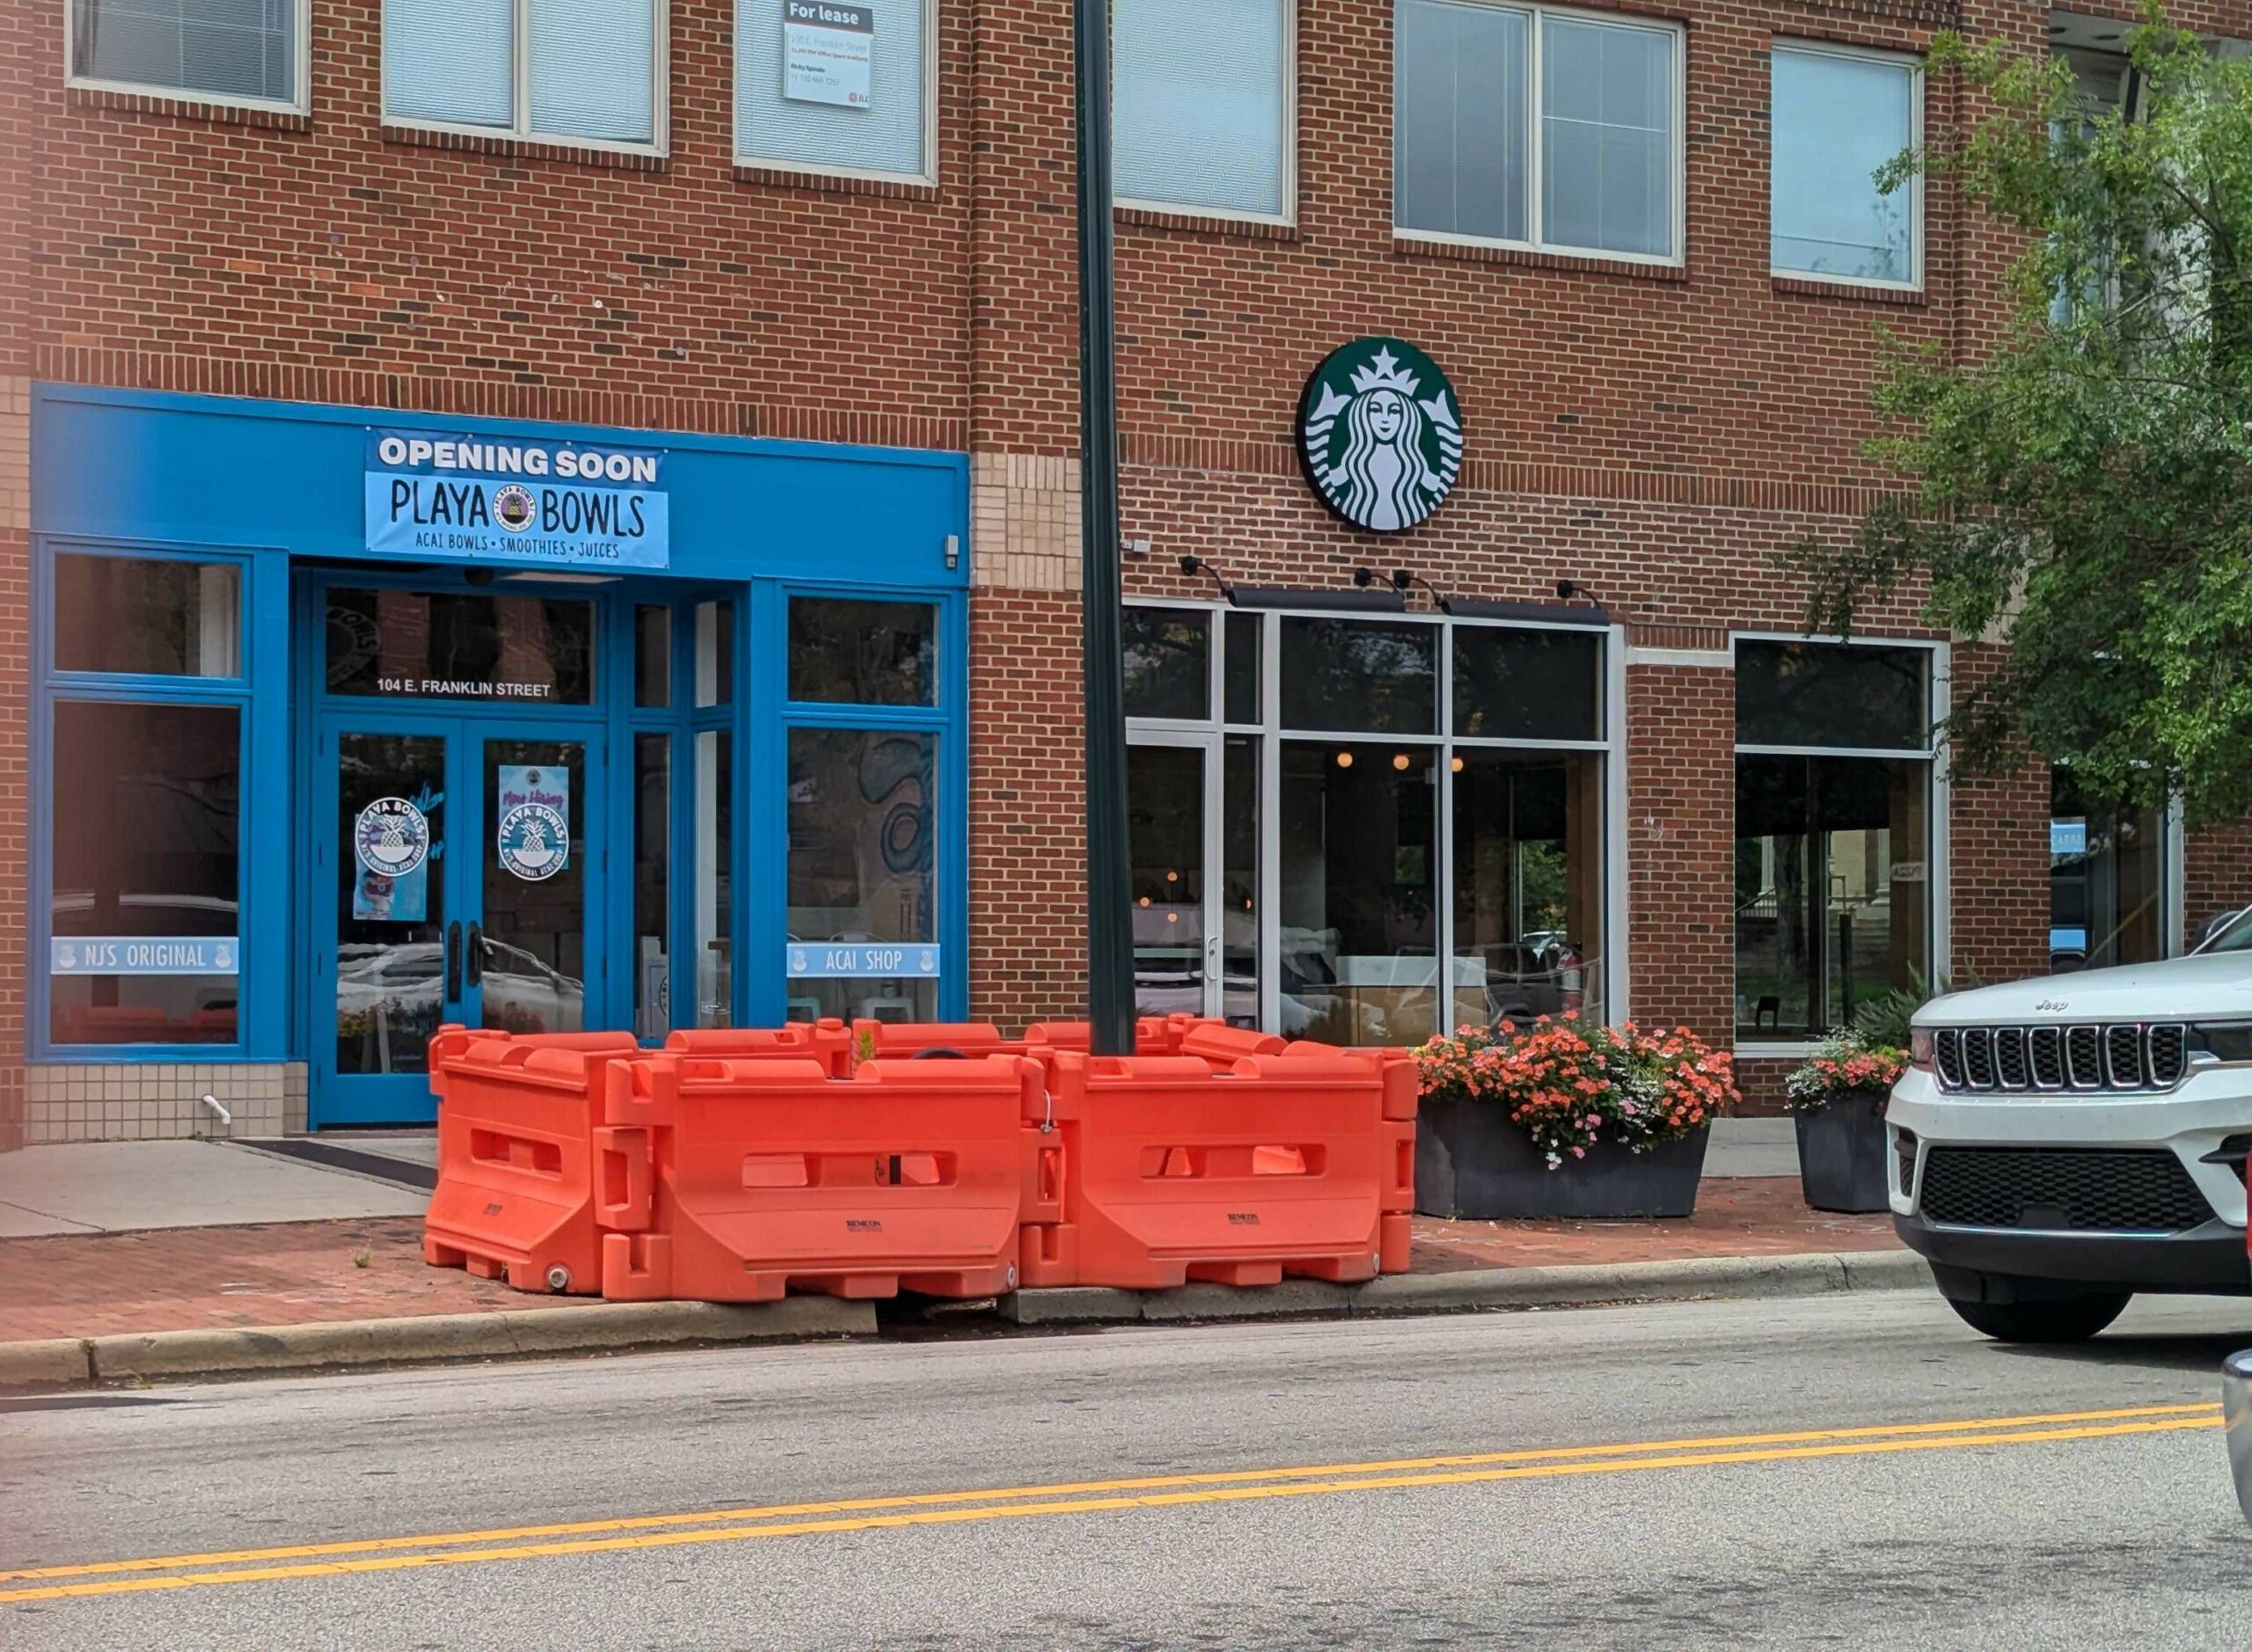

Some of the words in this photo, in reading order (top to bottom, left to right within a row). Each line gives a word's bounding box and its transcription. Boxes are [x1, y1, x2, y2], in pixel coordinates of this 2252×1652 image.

[789, 3, 816, 18] For
[819, 5, 859, 25] lease
[379, 437, 548, 475] OPENING
[555, 450, 656, 483] SOON
[391, 479, 490, 528] PLAYA
[542, 491, 645, 537] BOWLS
[416, 532, 443, 548] ACAI
[449, 533, 488, 551] BOWLS
[500, 537, 567, 556] SMOOTHIES
[578, 543, 619, 559] JUICES
[377, 678, 401, 692] 104
[405, 680, 418, 692] E.
[422, 680, 493, 695] FRANKLIN
[496, 683, 550, 698] STREET
[359, 801, 391, 832] PLAYA
[394, 801, 426, 833] BOWLS
[502, 808, 532, 837] PLAYA
[535, 808, 565, 839] BOWLS
[85, 944, 117, 966] NJ'S
[127, 945, 206, 967] ORIGINAL
[826, 950, 856, 970] ACAI
[866, 950, 902, 969] SHOP
[2036, 999, 2069, 1012] Jeep
